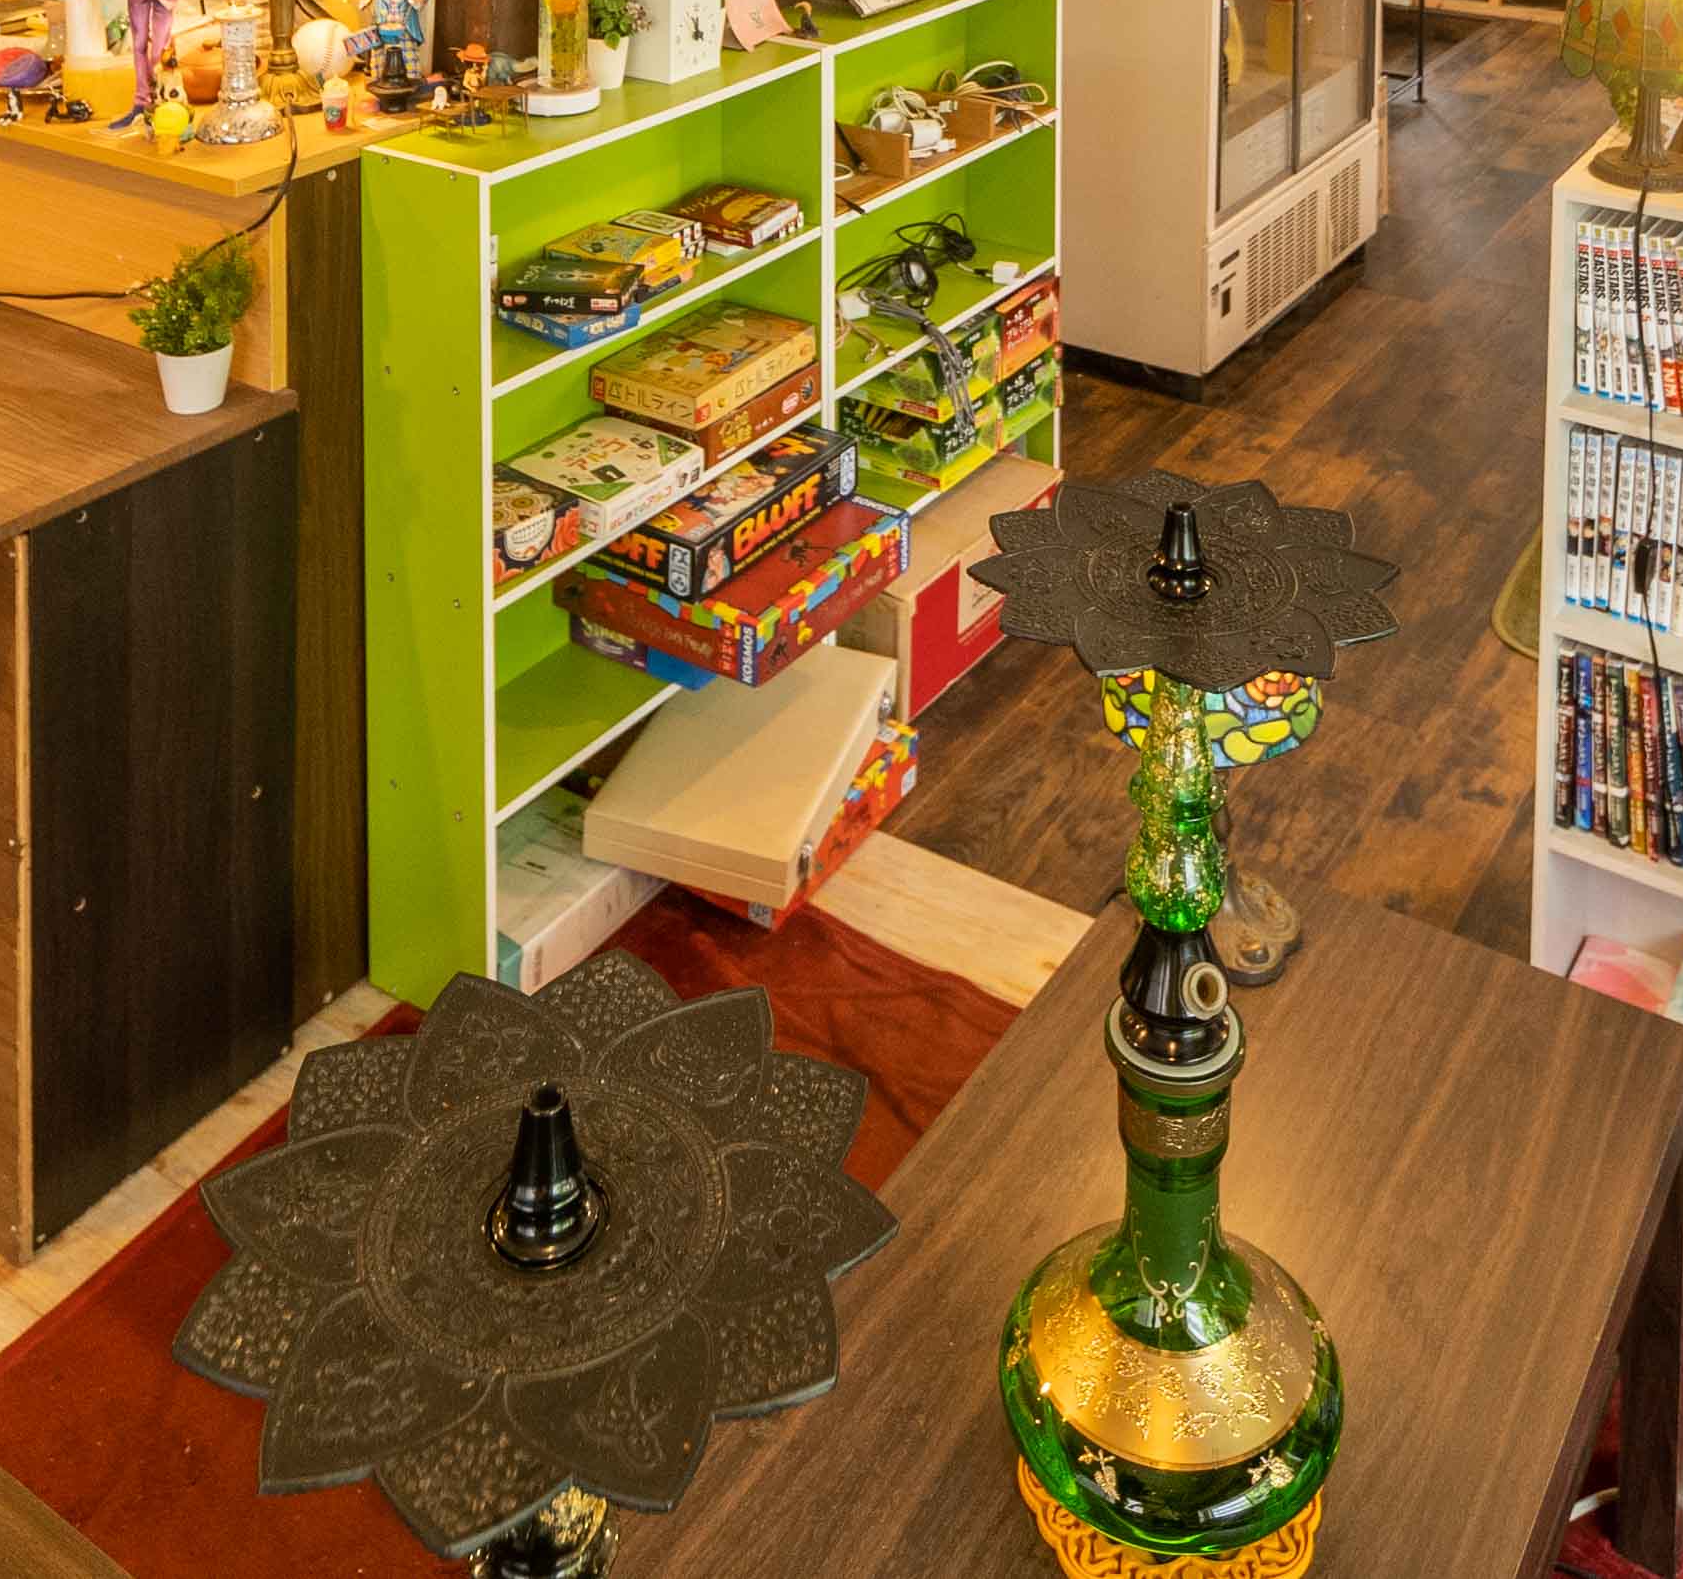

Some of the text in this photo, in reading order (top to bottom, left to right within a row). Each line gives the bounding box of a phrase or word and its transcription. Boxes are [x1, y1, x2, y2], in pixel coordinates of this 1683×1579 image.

[1577, 244, 1590, 295] BEASTARS
[1593, 246, 1606, 300] BEASTARS
[1607, 249, 1620, 302] BEASTARS
[1621, 248, 1636, 302] BEASTARS
[1651, 259, 1667, 312] BEASTARS
[1664, 260, 1682, 314] BEASTARS
[734, 473, 822, 561] BLUFF
[742, 626, 754, 684] KOSMOS
